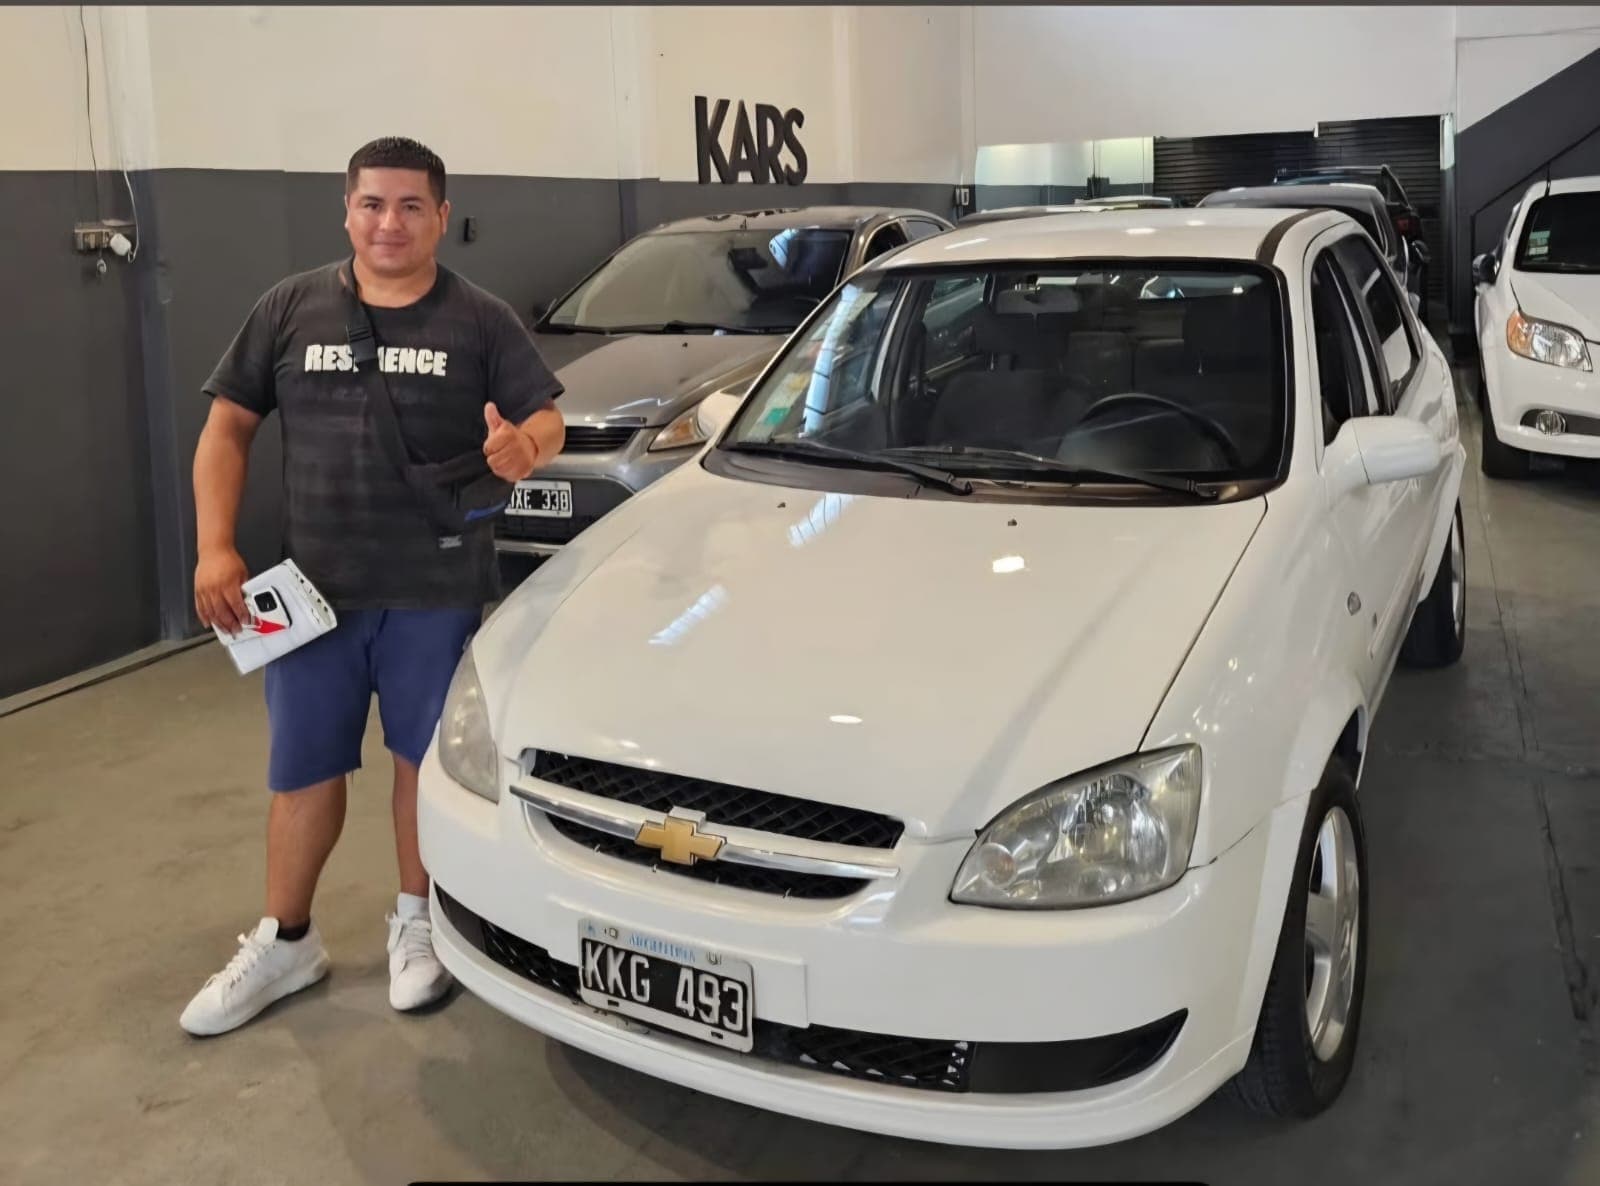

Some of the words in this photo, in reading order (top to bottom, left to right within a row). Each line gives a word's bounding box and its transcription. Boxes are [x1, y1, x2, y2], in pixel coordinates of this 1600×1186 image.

[695, 96, 807, 186] KARS
[305, 344, 447, 376] RESIENCE
[541, 490, 569, 512] 338
[584, 941, 650, 1003] KKG
[675, 966, 744, 1031] 493
